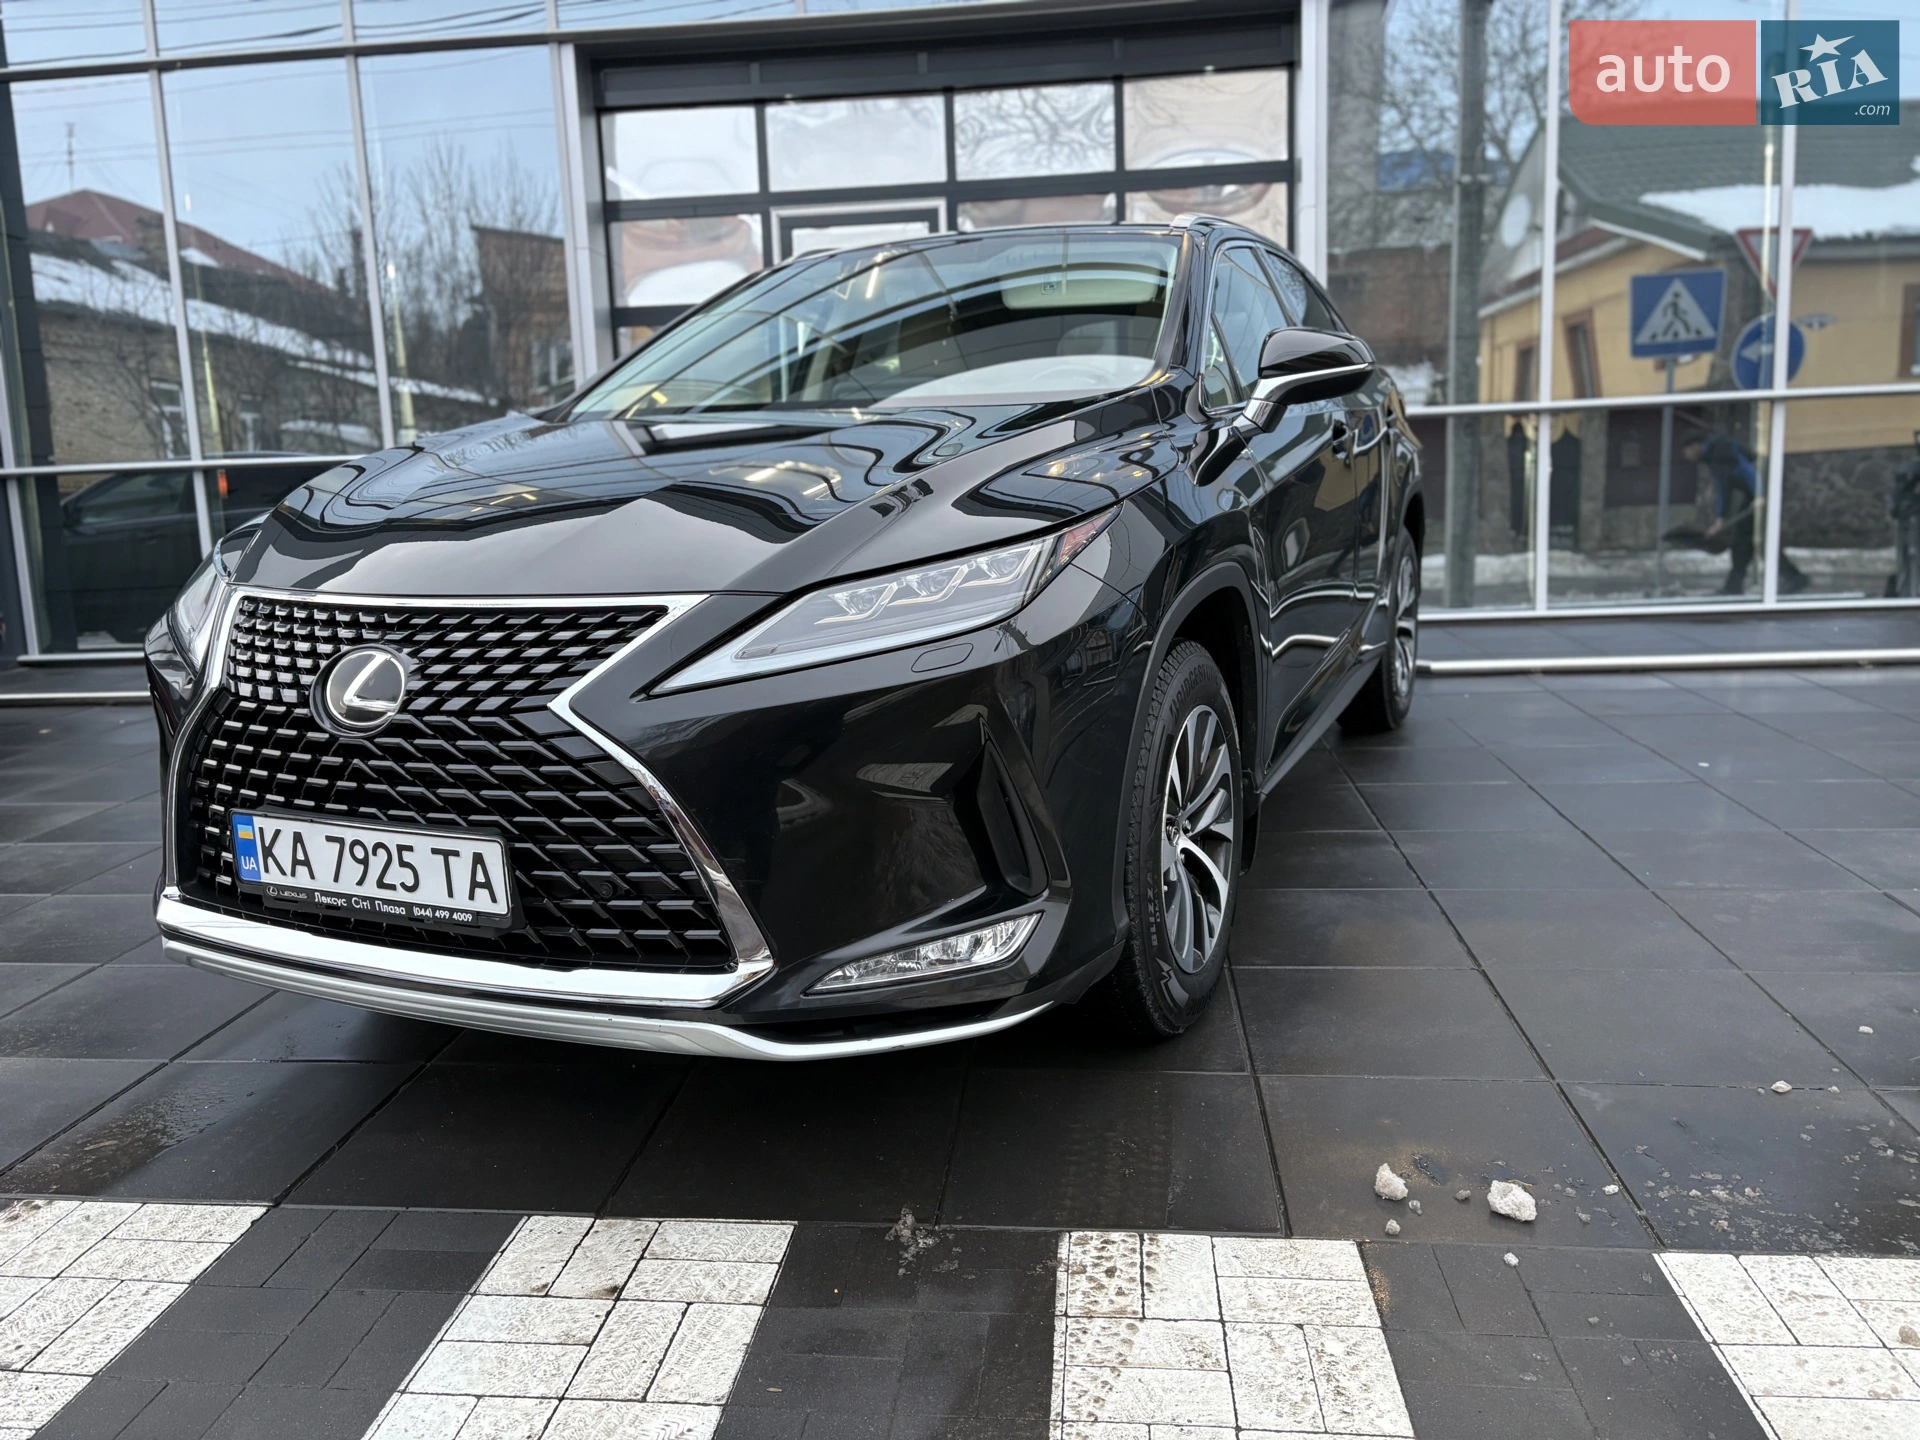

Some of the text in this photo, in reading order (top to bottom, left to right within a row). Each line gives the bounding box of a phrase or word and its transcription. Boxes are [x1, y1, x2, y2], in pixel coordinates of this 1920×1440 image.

[1170, 664, 1219, 726] BRIDGESTO
[241, 855, 258, 872] UA
[258, 826, 497, 903] KA 7925 TA
[279, 889, 308, 899] LEXUS
[314, 892, 348, 907] Лексус
[375, 900, 406, 915] Плаза
[413, 905, 433, 918] (044)
[434, 909, 450, 919] 499
[452, 912, 473, 922] 4009
[1146, 859, 1158, 947] BLIZZA
